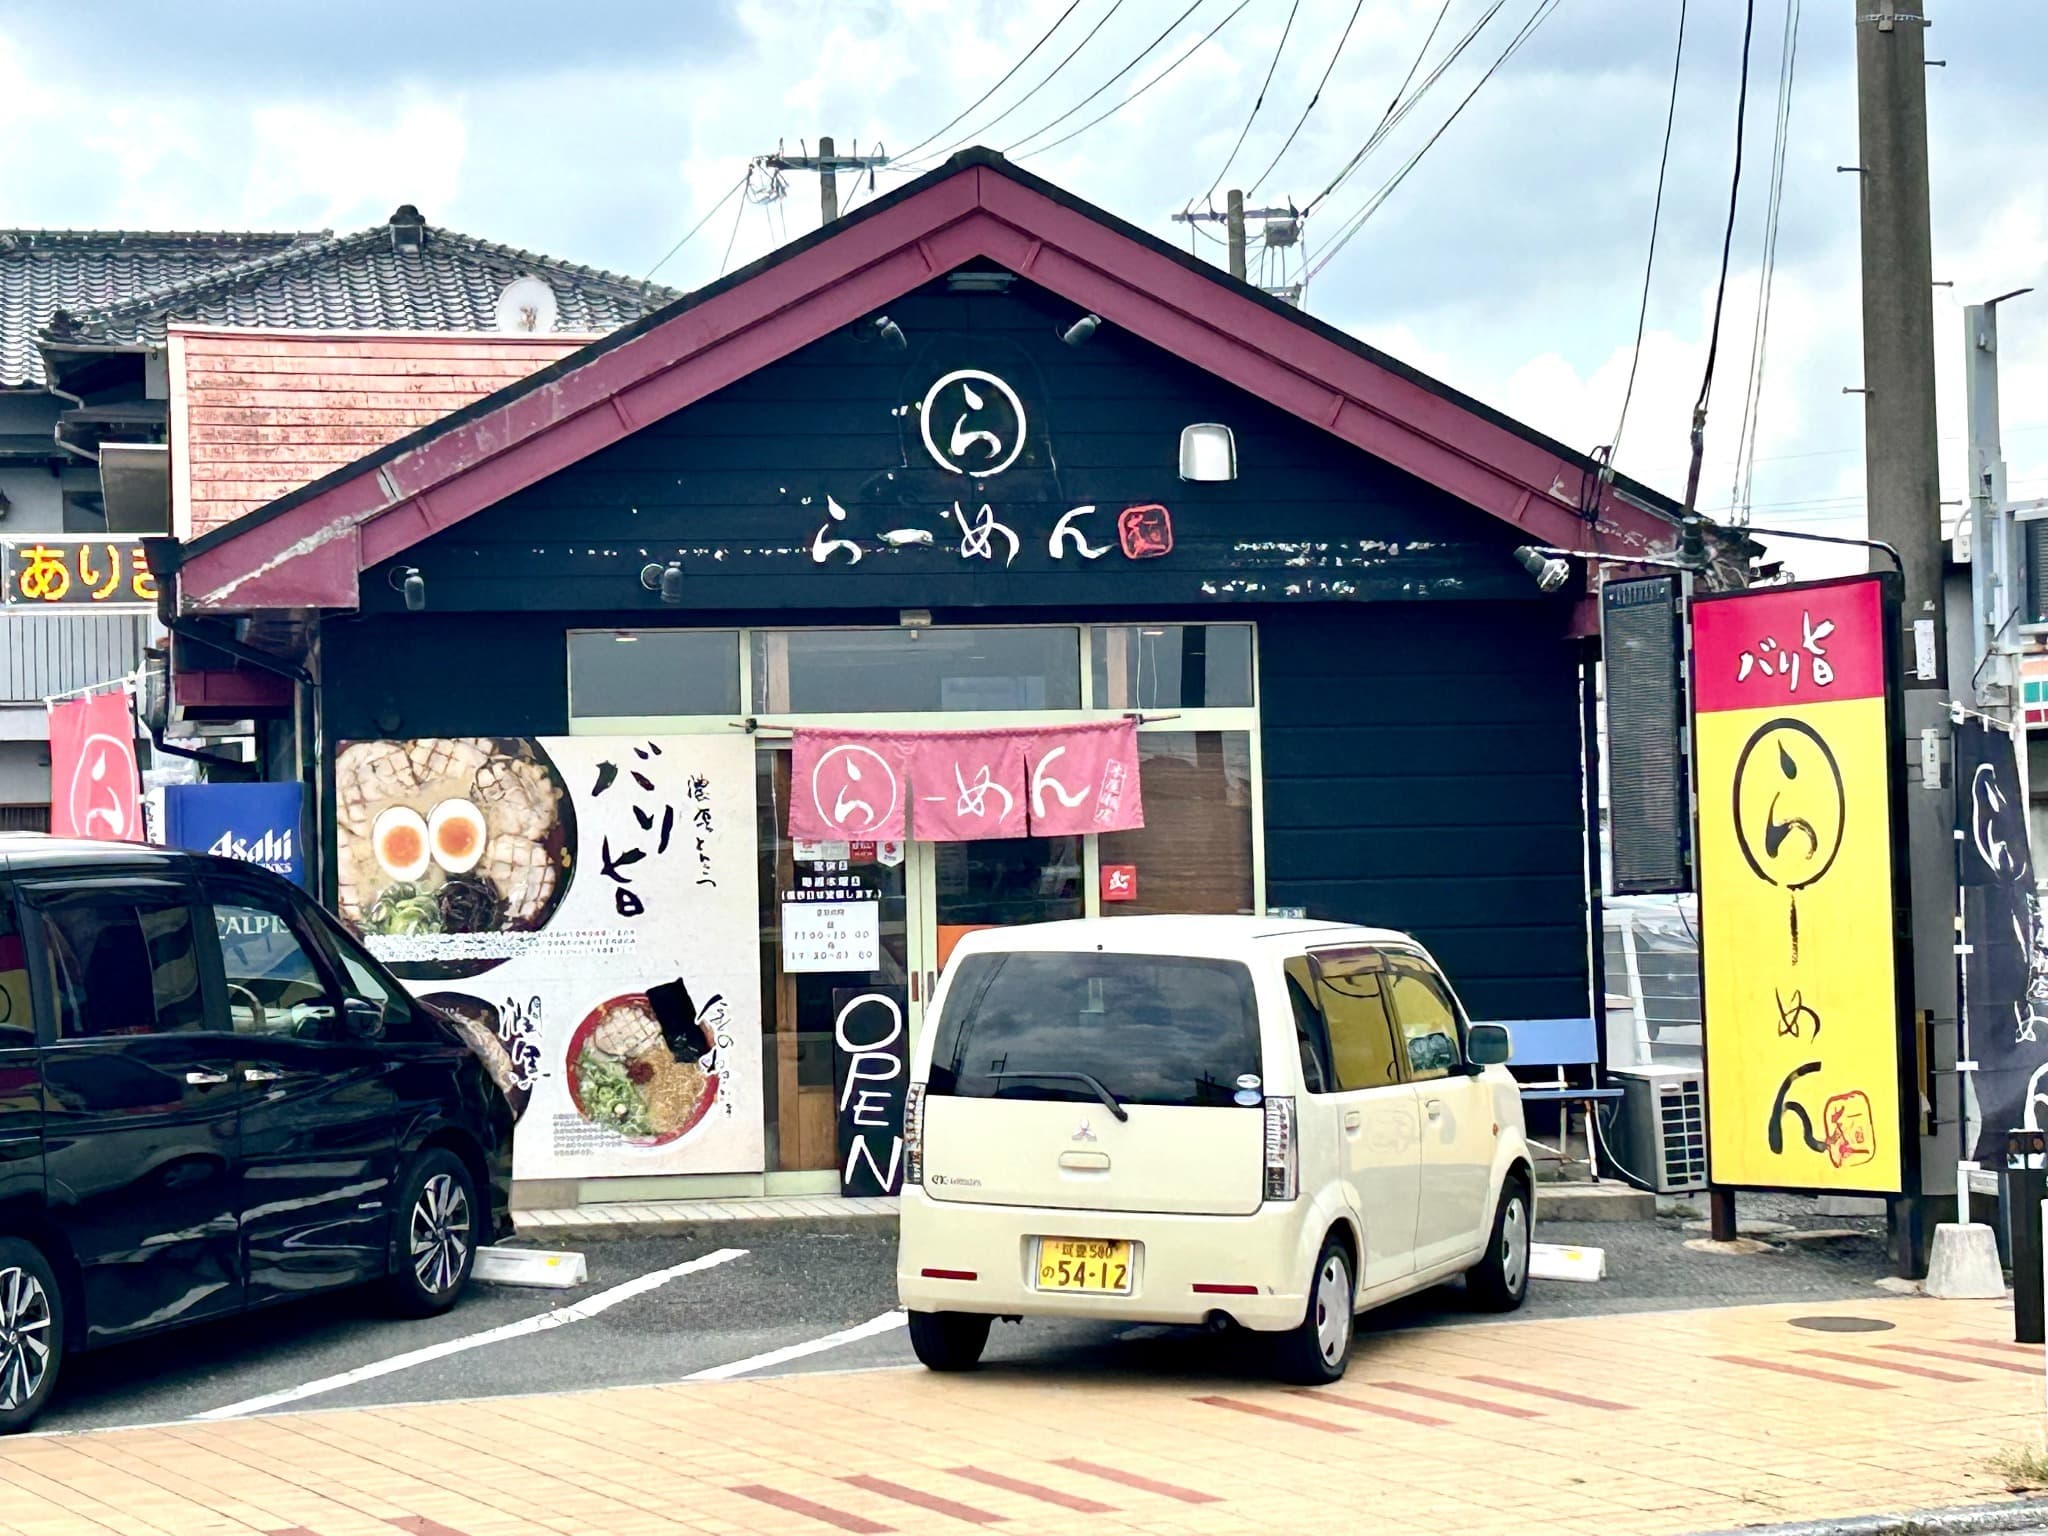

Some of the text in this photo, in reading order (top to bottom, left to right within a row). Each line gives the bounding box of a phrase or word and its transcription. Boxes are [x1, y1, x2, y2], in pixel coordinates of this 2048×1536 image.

[950, 383, 1002, 460] ら
[811, 494, 1114, 568] らーめん
[1736, 608, 1836, 692] バリ旨
[835, 993, 903, 1193] OPEN
